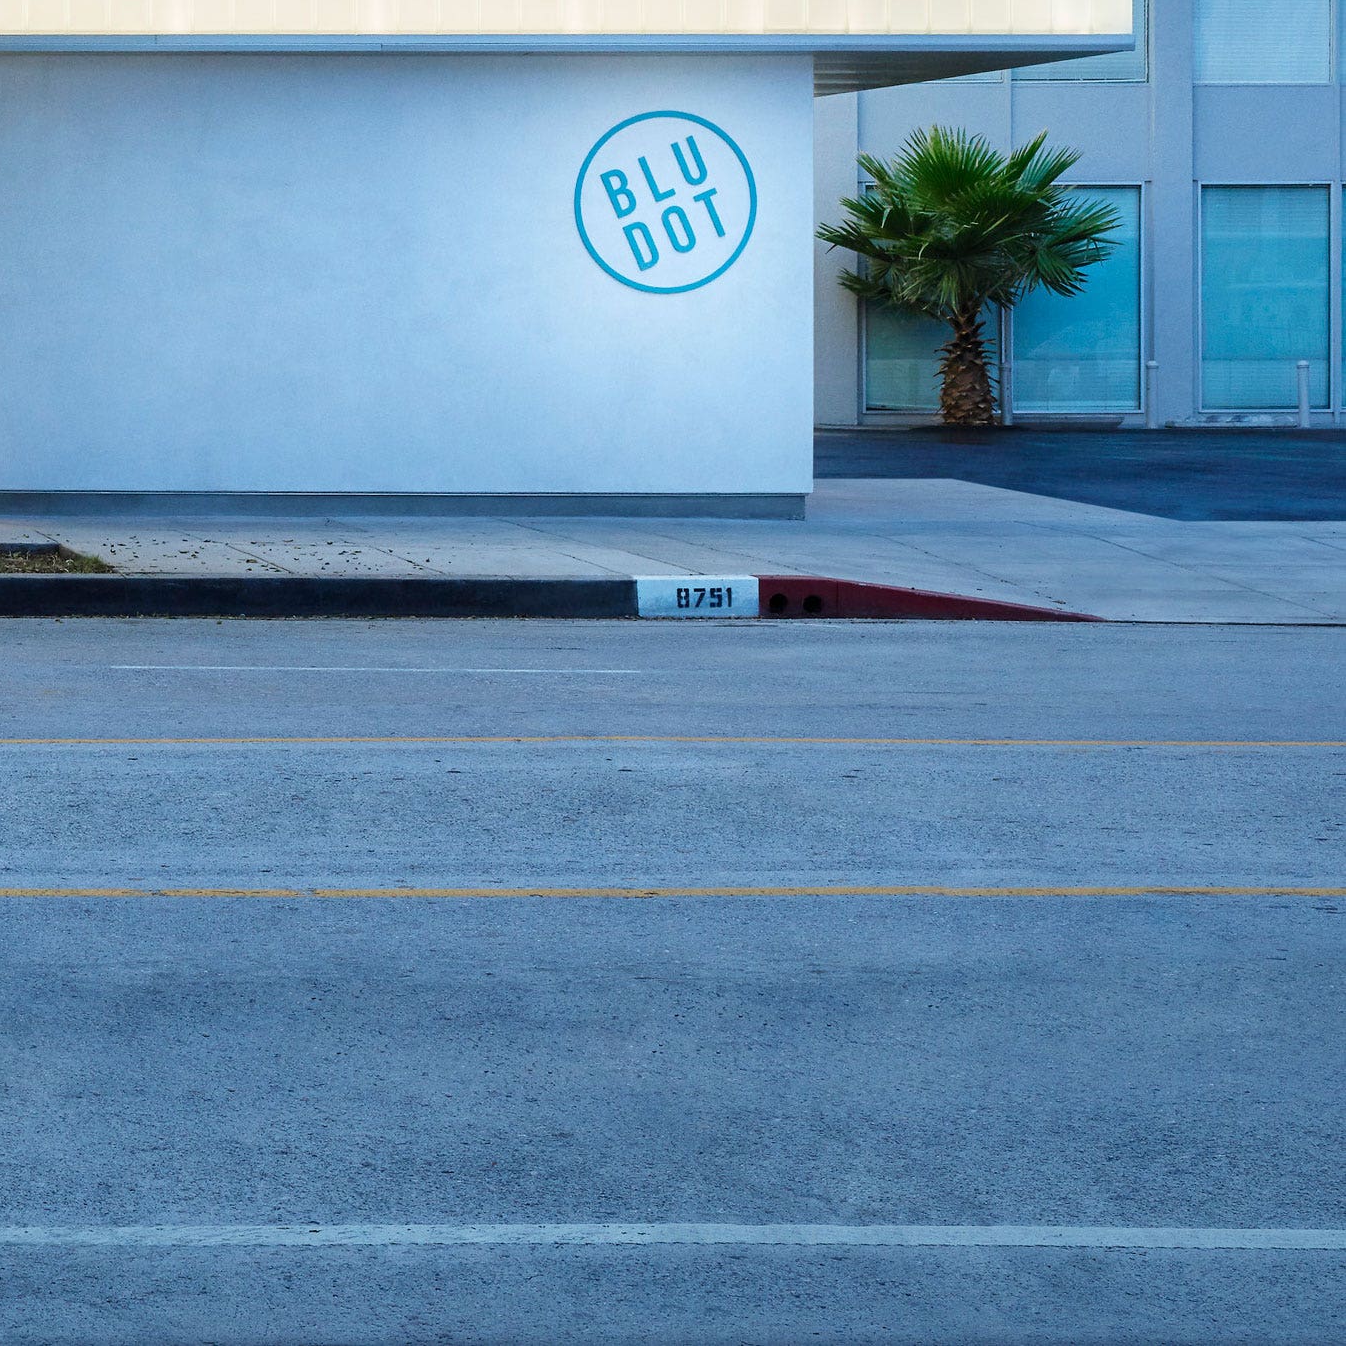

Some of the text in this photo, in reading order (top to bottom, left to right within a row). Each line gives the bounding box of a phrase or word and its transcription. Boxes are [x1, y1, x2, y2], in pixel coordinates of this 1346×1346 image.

[600, 135, 708, 219] BLU
[622, 187, 726, 271] DOT
[676, 587, 733, 609] 8751
